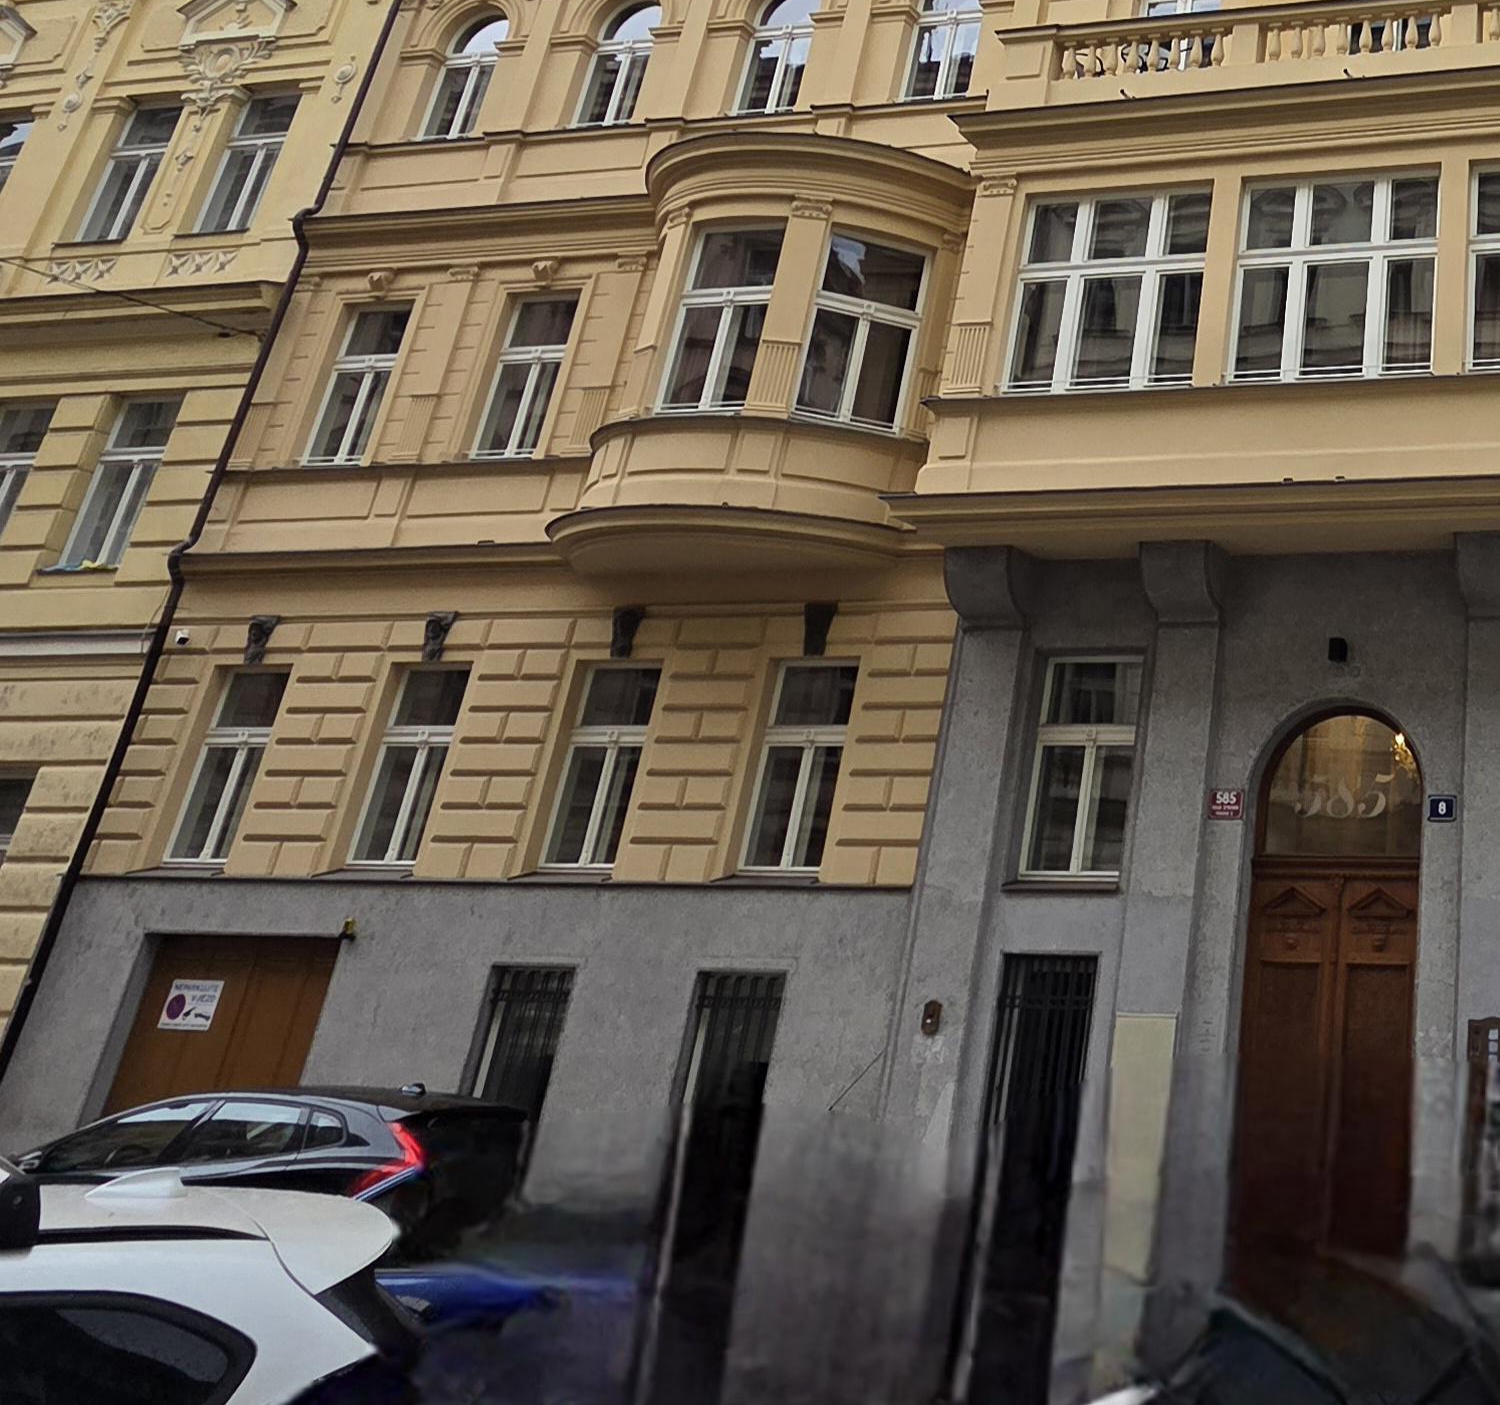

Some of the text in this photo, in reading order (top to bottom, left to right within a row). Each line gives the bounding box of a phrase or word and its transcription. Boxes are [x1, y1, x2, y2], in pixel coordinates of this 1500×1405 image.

[1216, 791, 1237, 804] 585
[1294, 773, 1395, 818] 585
[1438, 801, 1446, 815] 8
